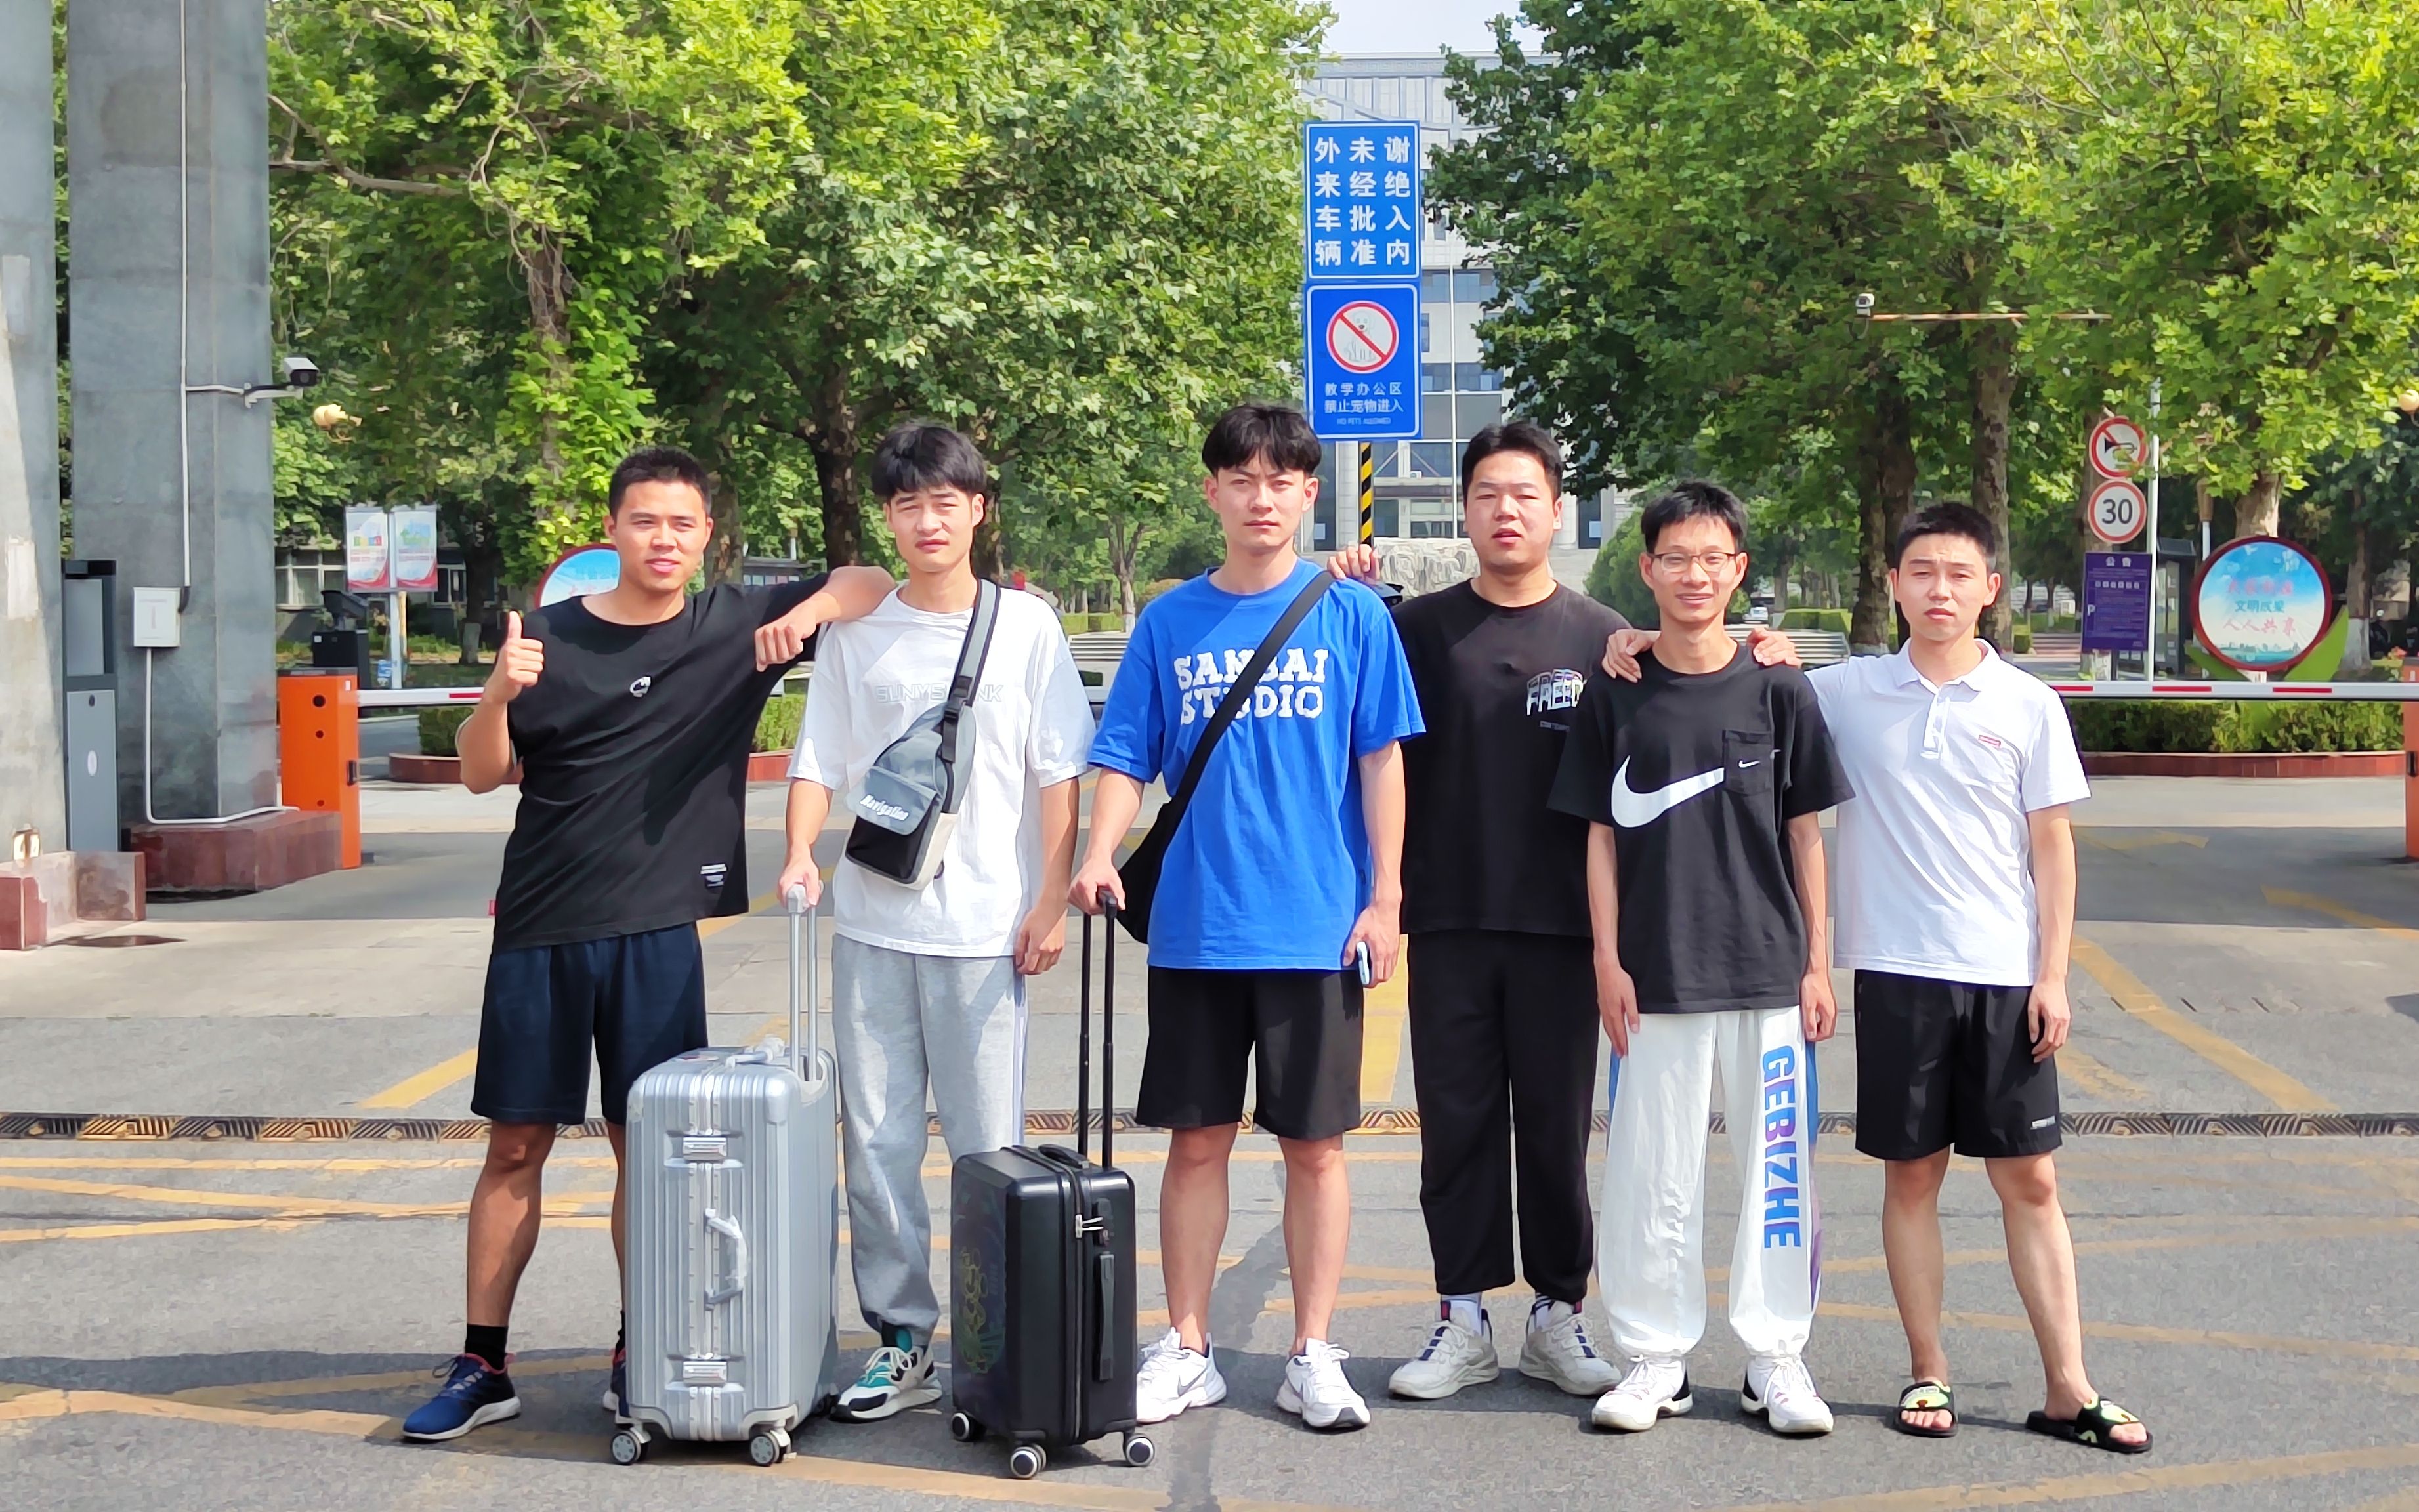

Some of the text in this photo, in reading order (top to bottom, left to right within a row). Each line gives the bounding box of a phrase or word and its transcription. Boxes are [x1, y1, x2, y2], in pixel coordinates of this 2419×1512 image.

[1315, 136, 1341, 266] 外来车辆
[1349, 136, 1376, 266] 未经批准
[1384, 136, 1412, 266] 谢绝入内
[1324, 382, 1402, 396] 教学办公区
[1324, 399, 1404, 413] 禁止宠物进入
[2102, 499, 2133, 524] 30
[1763, 1045, 1801, 1249] GEBIZHE
